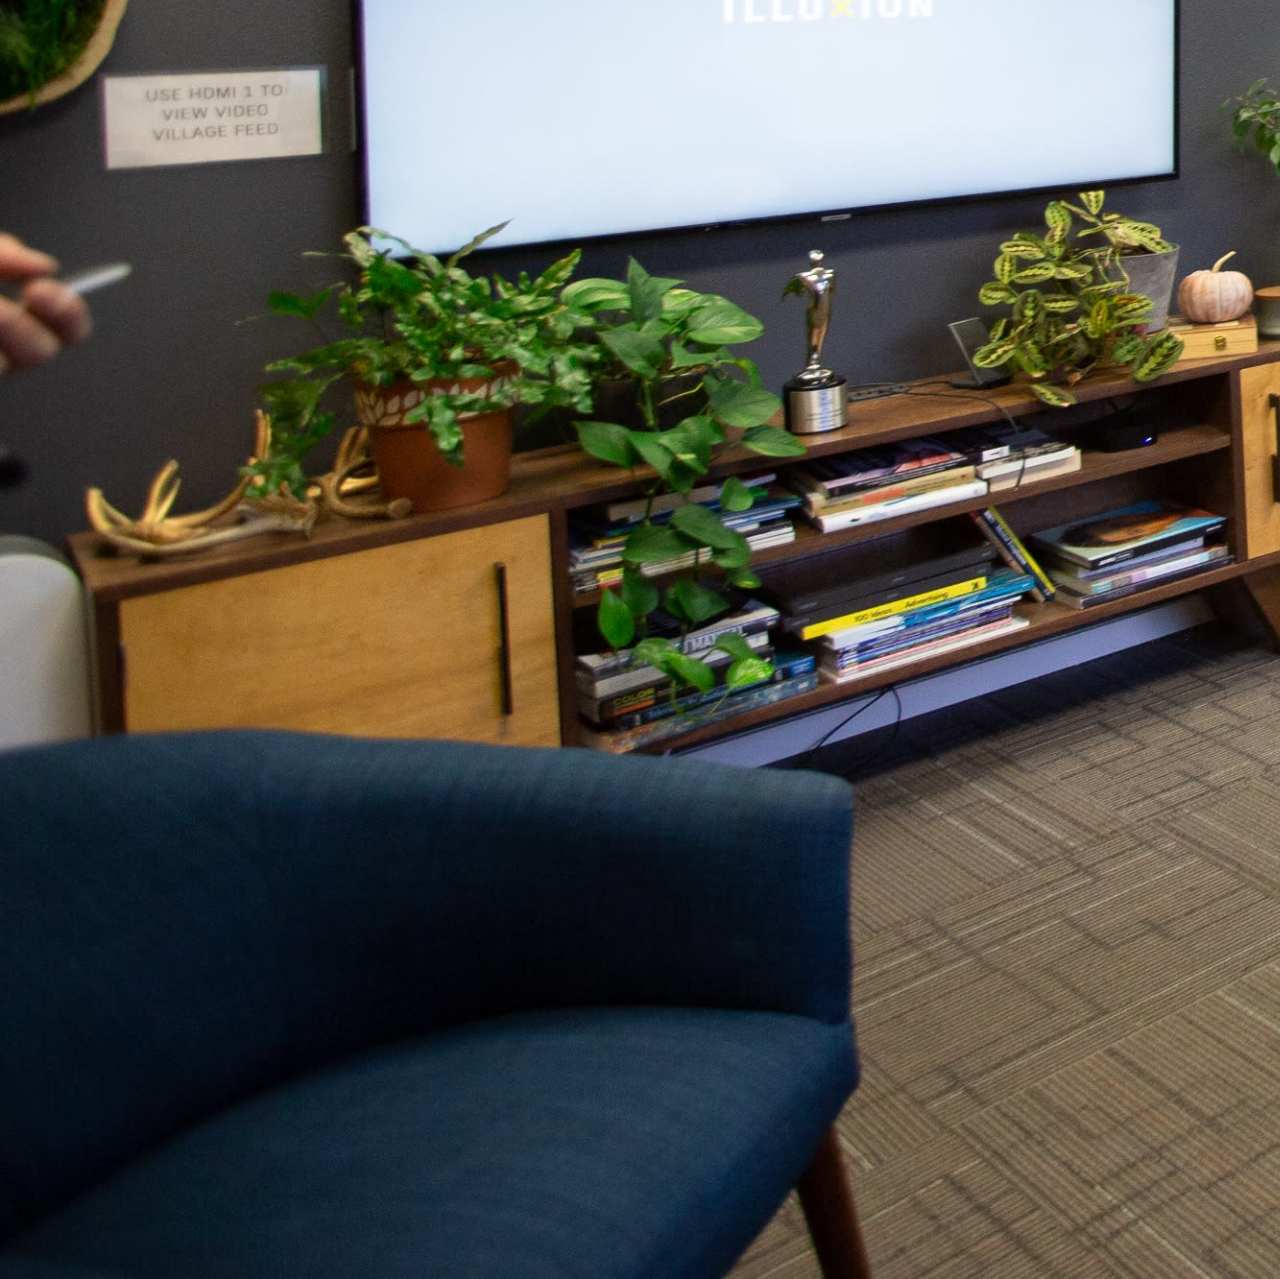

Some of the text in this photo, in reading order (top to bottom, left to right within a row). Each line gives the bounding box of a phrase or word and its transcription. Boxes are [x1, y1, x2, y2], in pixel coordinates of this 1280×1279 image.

[146, 87, 182, 102] USE
[189, 86, 236, 101] HDMI
[261, 84, 283, 97] TO
[162, 104, 268, 121] VIEW VIDEO
[152, 122, 279, 141] VILLAGE FEED
